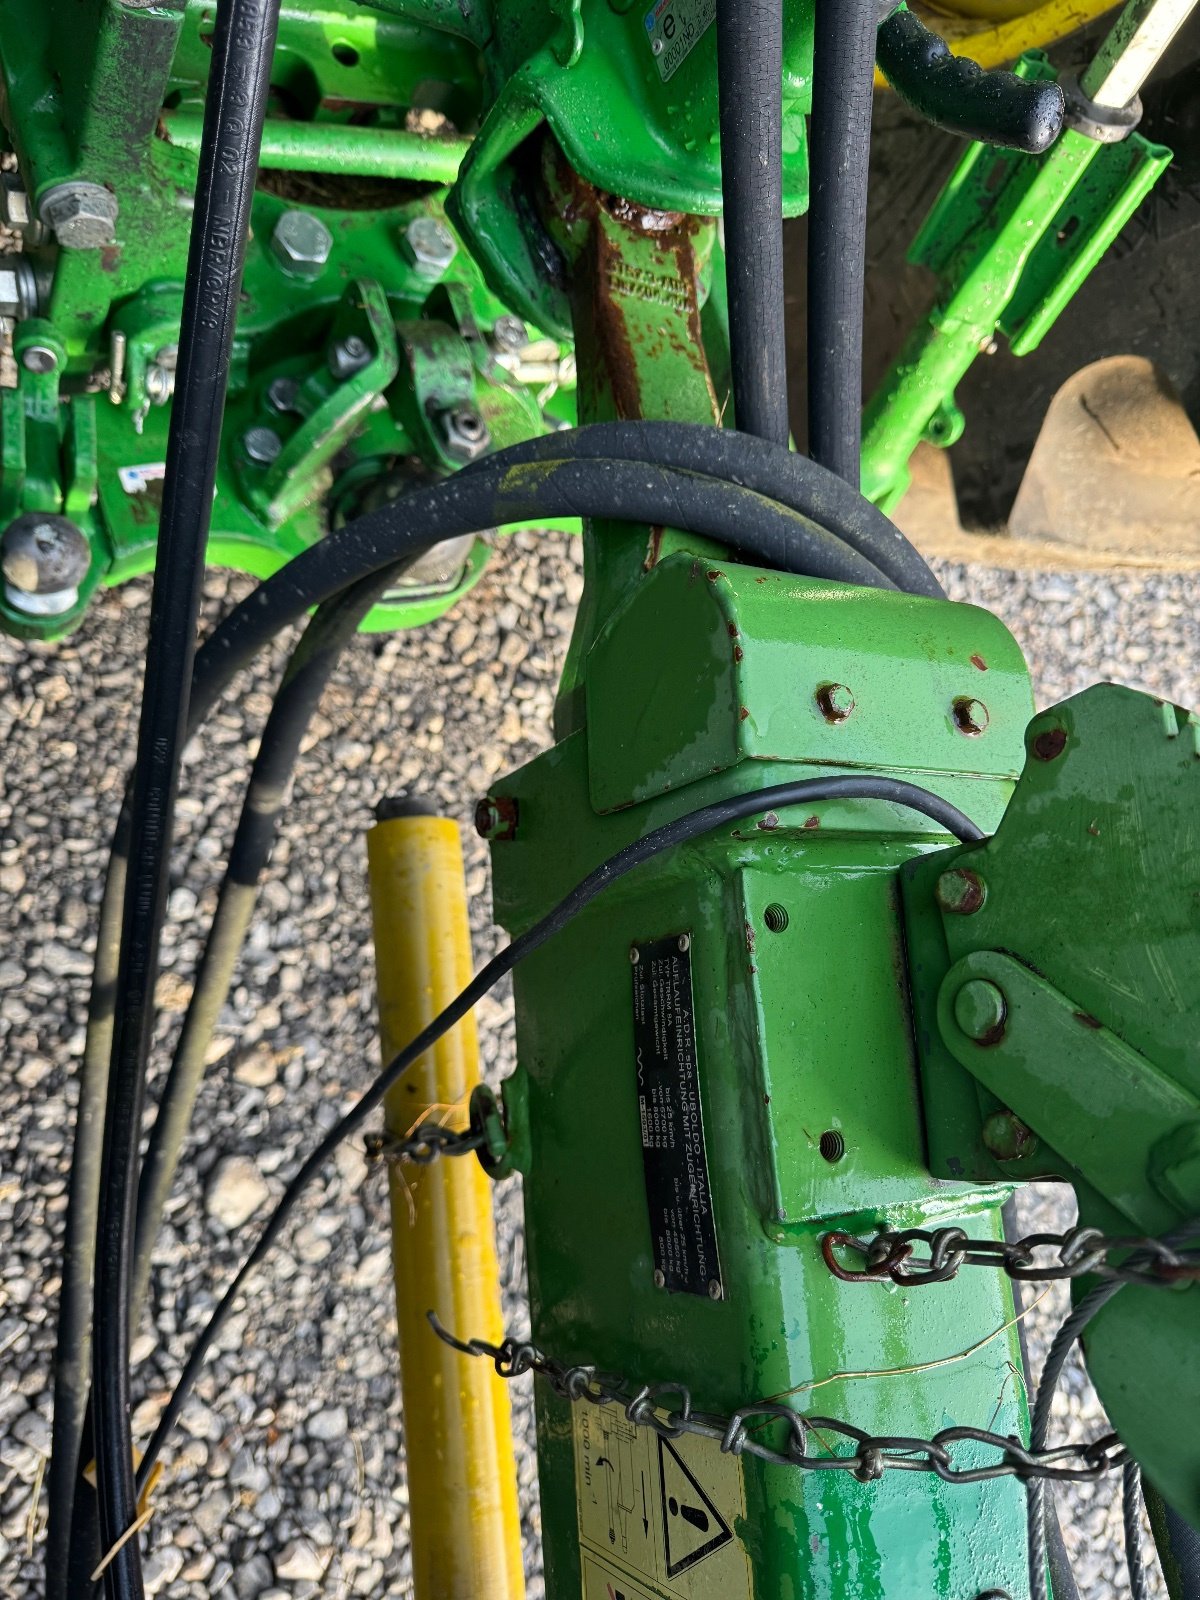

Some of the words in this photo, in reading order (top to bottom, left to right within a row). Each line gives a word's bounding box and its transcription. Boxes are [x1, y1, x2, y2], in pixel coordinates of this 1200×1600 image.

[652, 980, 660, 1055] Gesamtgewicht
[659, 979, 668, 1060] Geschwindigkeit
[672, 956, 688, 1111] AUFLAUFEINRICHTUNG
[683, 1116, 691, 1138] MIT
[667, 1106, 673, 1118] 25
[648, 1136, 654, 1147] kg
[655, 1136, 660, 1148] kg
[662, 1136, 668, 1148] kg
[689, 1092, 700, 1154] UBOLDO
[697, 1168, 707, 1215] ITALIA
[680, 1234, 686, 1246] 25
[661, 1259, 666, 1271] kg
[668, 1260, 673, 1272] kg
[676, 1260, 681, 1273] kg
[581, 1411, 590, 1449] 1000
[584, 1455, 592, 1486] min
